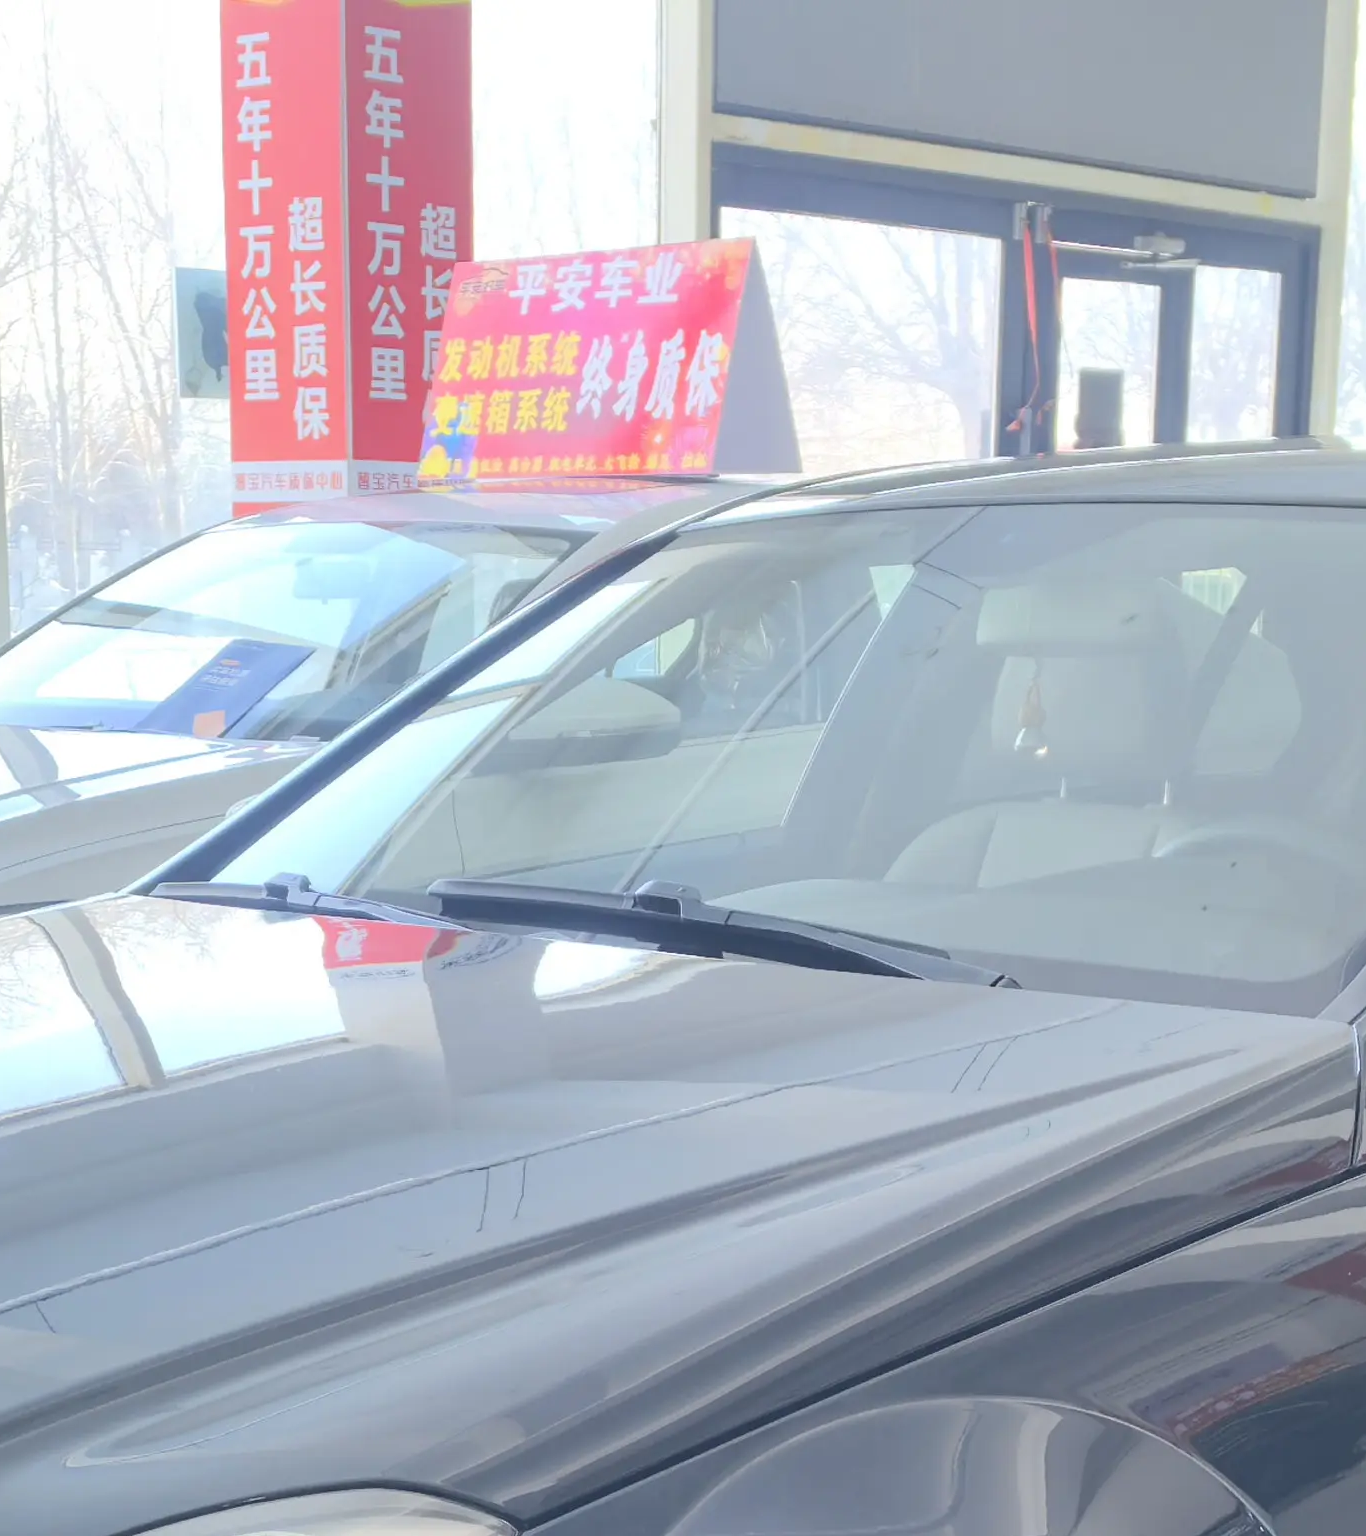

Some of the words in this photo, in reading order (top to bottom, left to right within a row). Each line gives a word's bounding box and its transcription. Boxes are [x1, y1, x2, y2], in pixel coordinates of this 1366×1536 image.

[236, 31, 281, 402] 五年十万公里
[364, 25, 408, 402] 五年十万公里
[288, 197, 330, 440] 超长质保
[508, 251, 684, 316] 平安车业
[438, 329, 582, 383] 发动机系统
[575, 328, 723, 422] 终身质保
[430, 385, 572, 437] 变速箱系统
